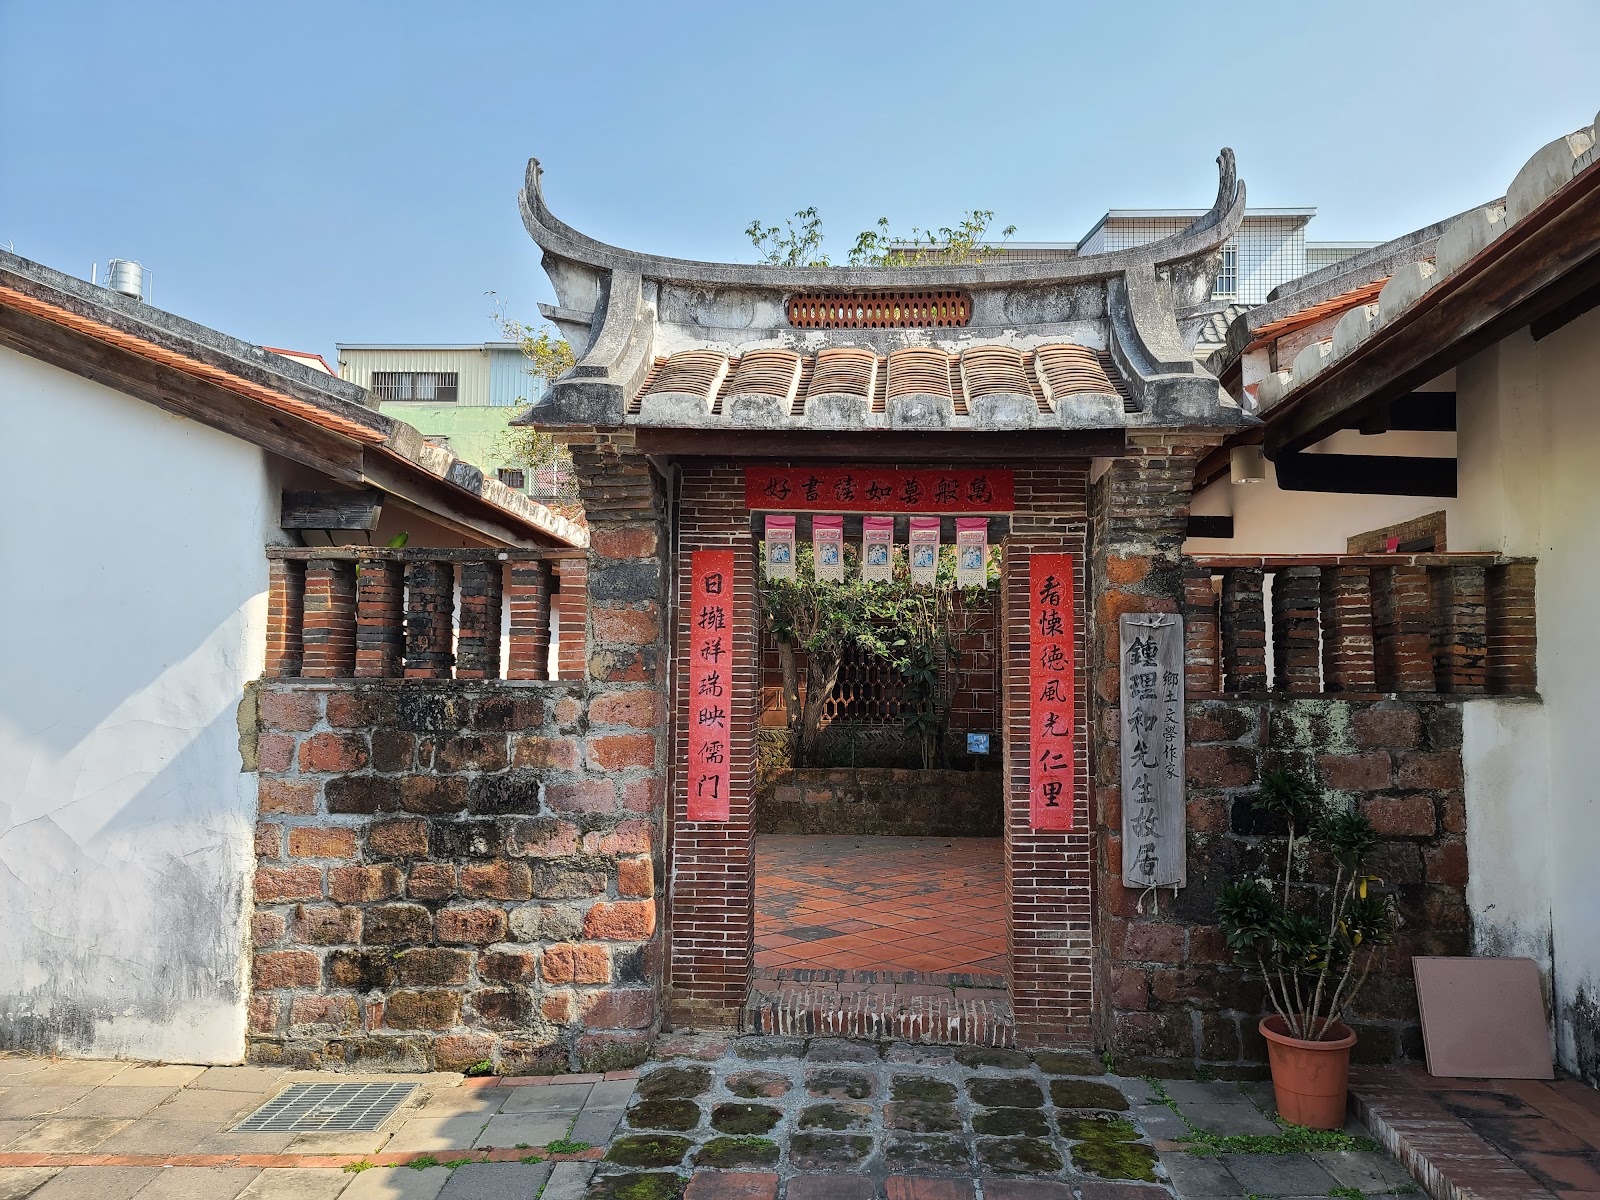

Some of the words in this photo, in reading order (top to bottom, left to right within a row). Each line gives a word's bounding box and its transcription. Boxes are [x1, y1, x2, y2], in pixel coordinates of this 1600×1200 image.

[1125, 634, 1163, 877] 鍾理和先生故居
[1162, 670, 1181, 780] 鄉土文學作家
